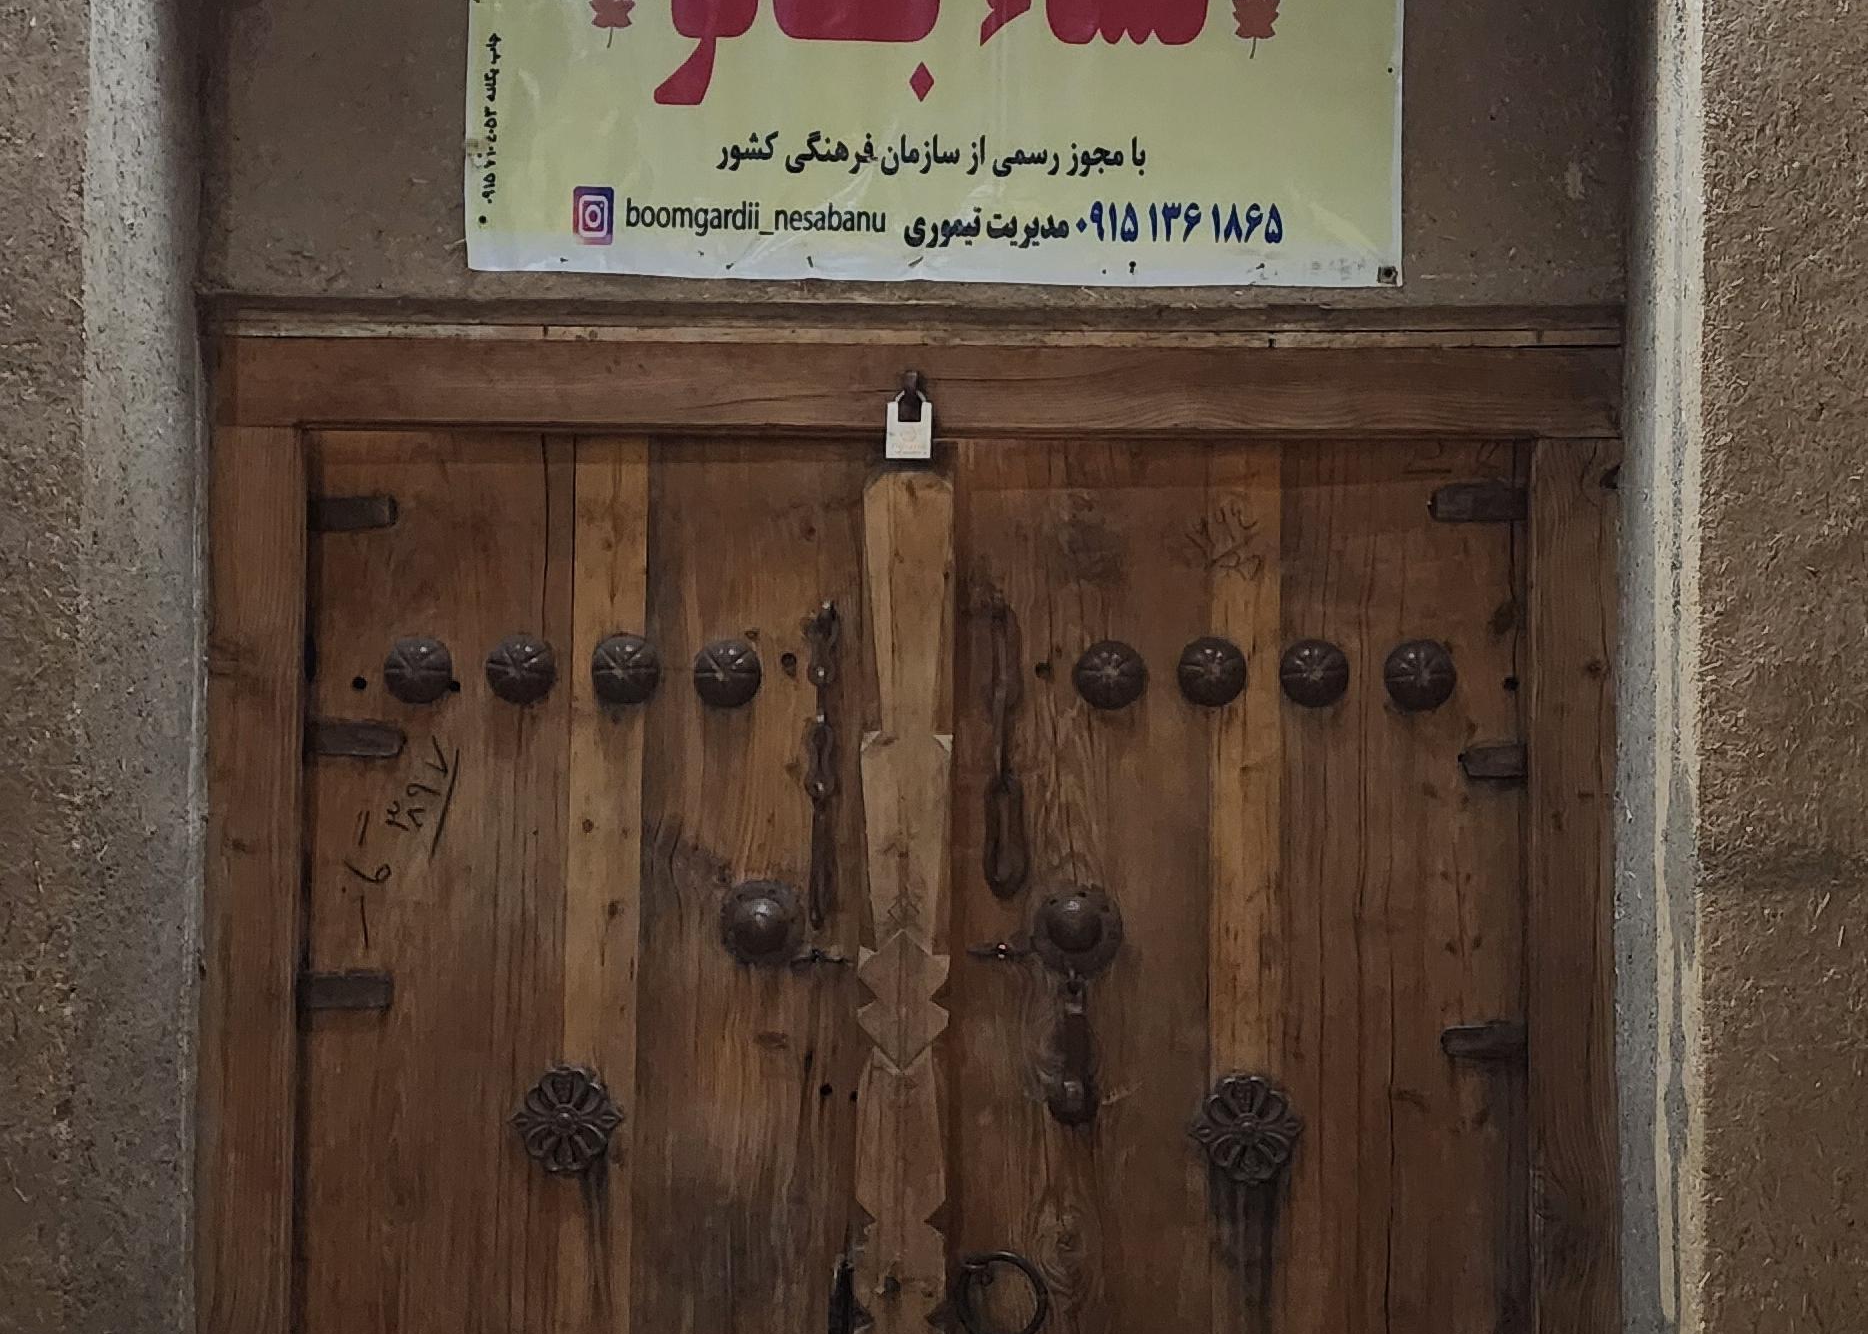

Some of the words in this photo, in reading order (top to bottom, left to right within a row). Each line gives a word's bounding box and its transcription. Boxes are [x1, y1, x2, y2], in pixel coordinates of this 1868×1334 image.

[716, 131, 779, 171] کشور
[785, 131, 876, 174] فرهنگی
[880, 134, 960, 176] سازمان
[966, 135, 986, 175] از
[992, 145, 1060, 177] رسمی
[1066, 142, 1124, 177] مجوز
[1131, 136, 1146, 176] با
[626, 197, 886, 237] boomgardii_nesabanu
[904, 207, 982, 248] تیموری
[986, 212, 1070, 248] مدیریت
[1075, 200, 1139, 244] ۰۹۱۵
[1149, 202, 1202, 243] ۱۳۶
[1211, 202, 1283, 244] ۱۸۶۵
